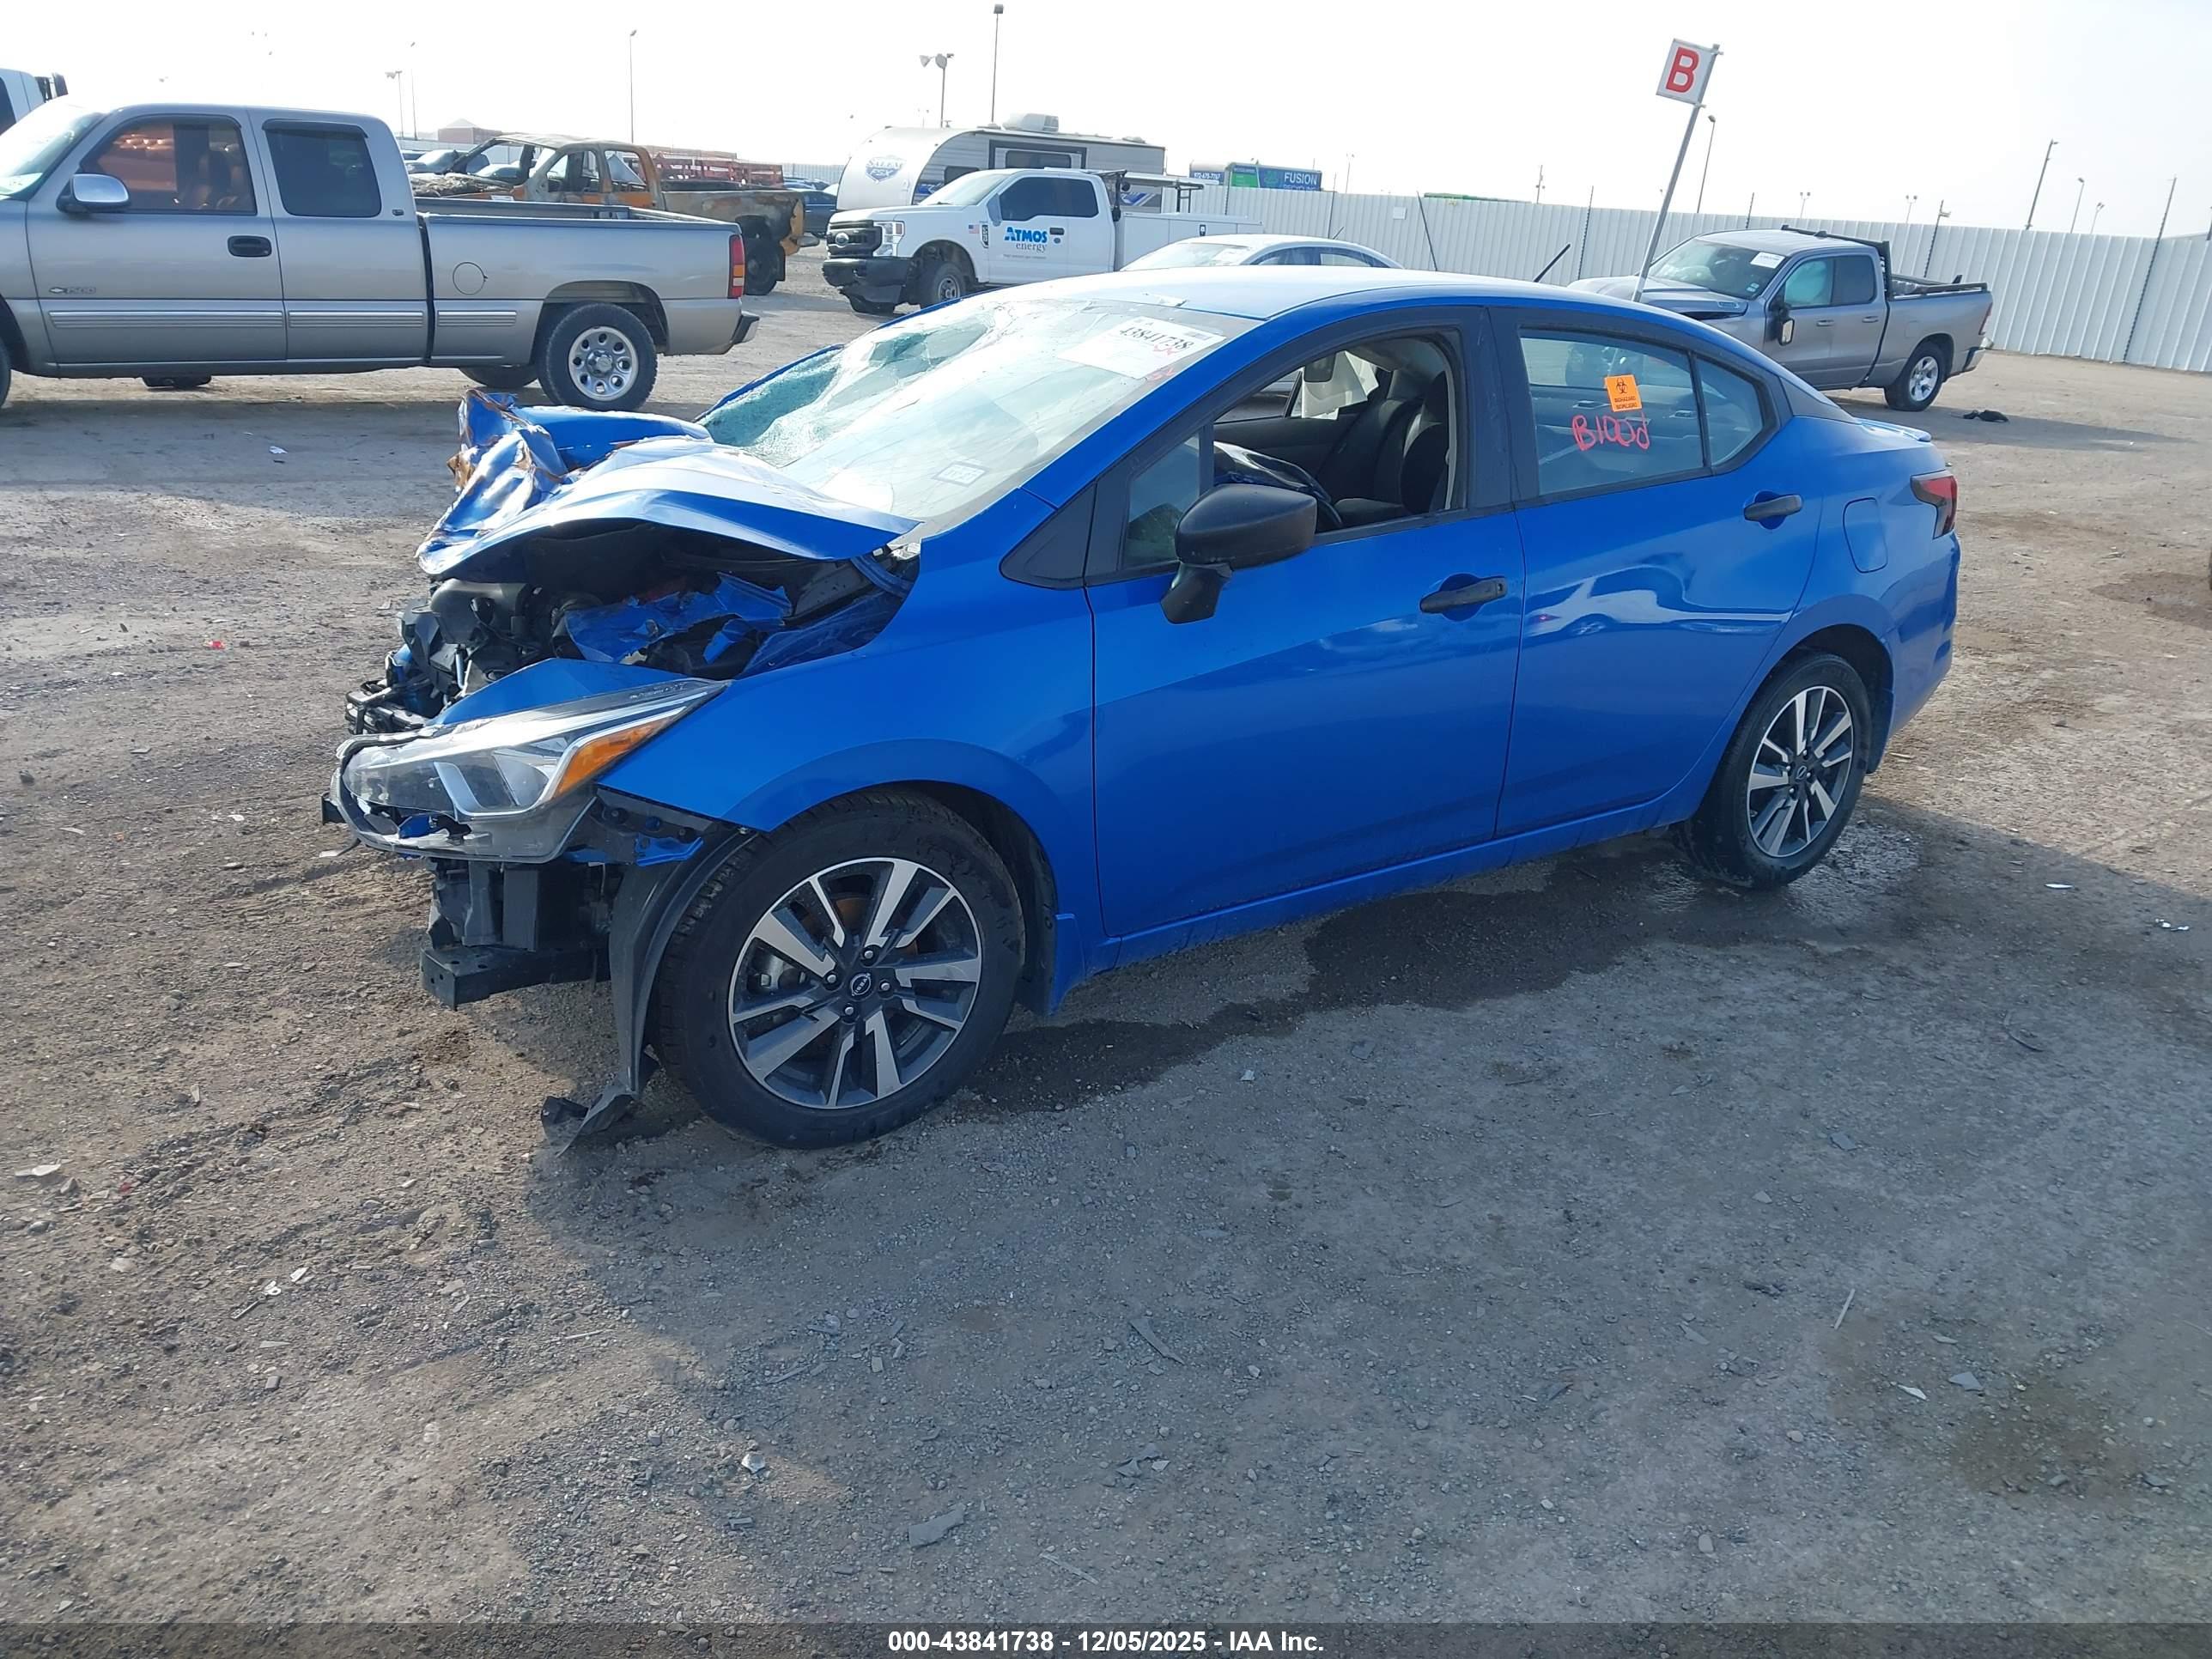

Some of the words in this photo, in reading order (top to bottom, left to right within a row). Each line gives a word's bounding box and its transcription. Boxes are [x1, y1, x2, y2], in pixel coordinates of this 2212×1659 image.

[1666, 46, 1699, 93] B
[1284, 172, 1317, 185] FUSION
[1004, 227, 1048, 243] ATMOS
[1016, 243, 1047, 252] energy
[1119, 326, 1194, 349] 43841738
